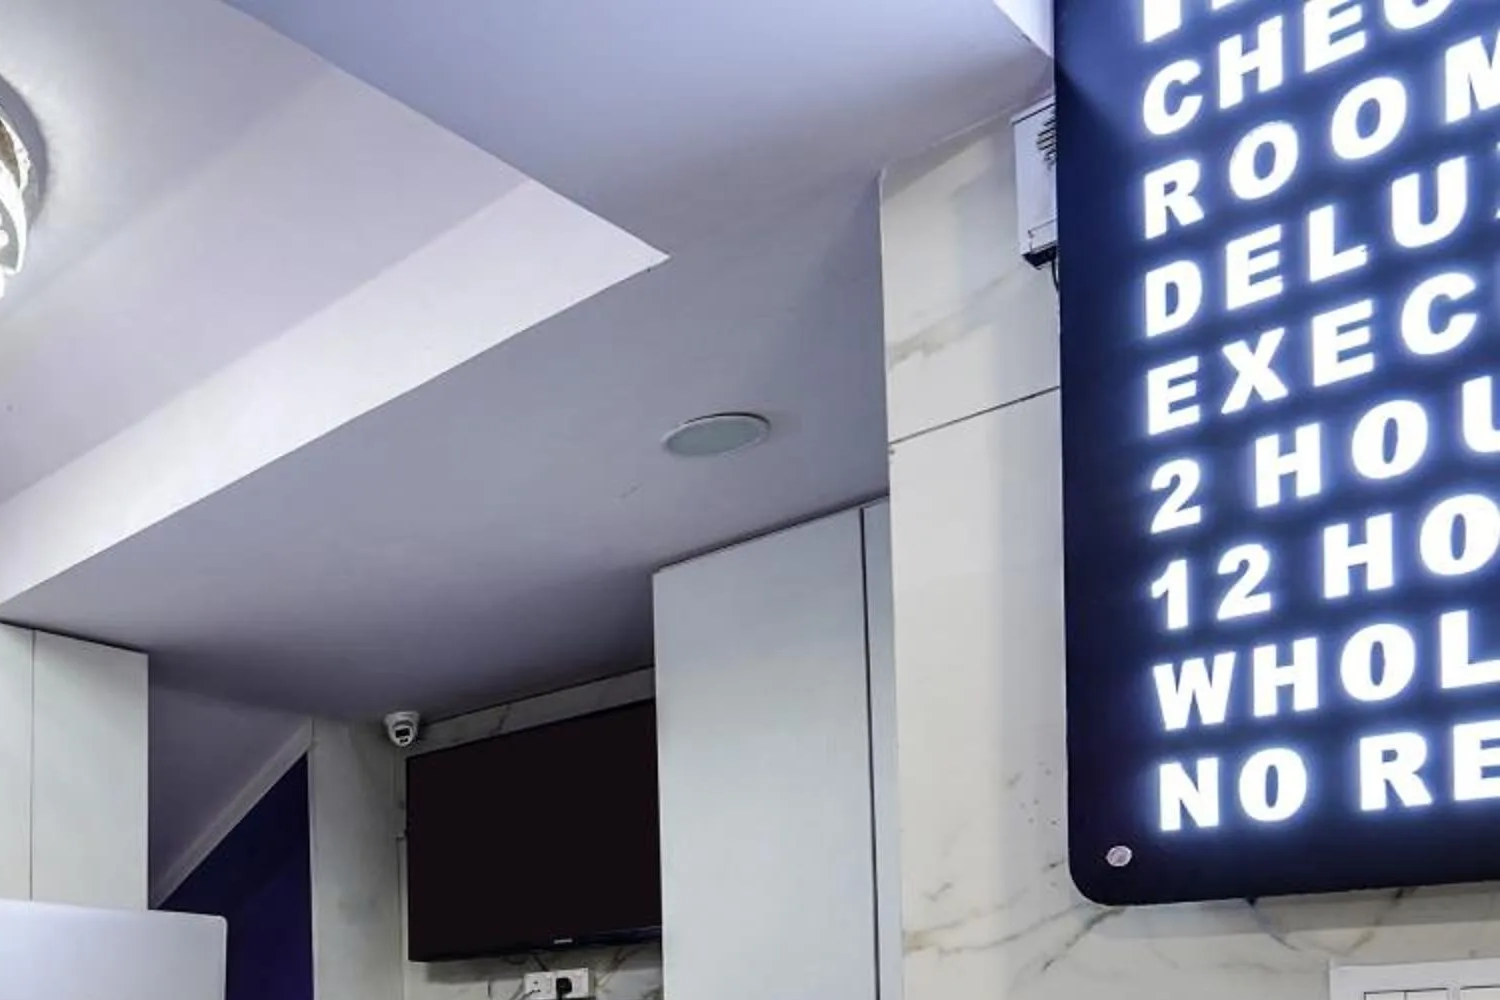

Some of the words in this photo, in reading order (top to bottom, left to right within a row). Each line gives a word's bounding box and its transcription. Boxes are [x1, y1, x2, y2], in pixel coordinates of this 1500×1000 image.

[1144, 142, 1500, 338] DELU
[1146, 271, 1478, 436] EXEC
[1150, 458, 1204, 534] 2
[1150, 543, 1272, 630] 12
[1323, 493, 1500, 599] HO
[1158, 747, 1308, 832] NO
[1358, 718, 1500, 812] RE
